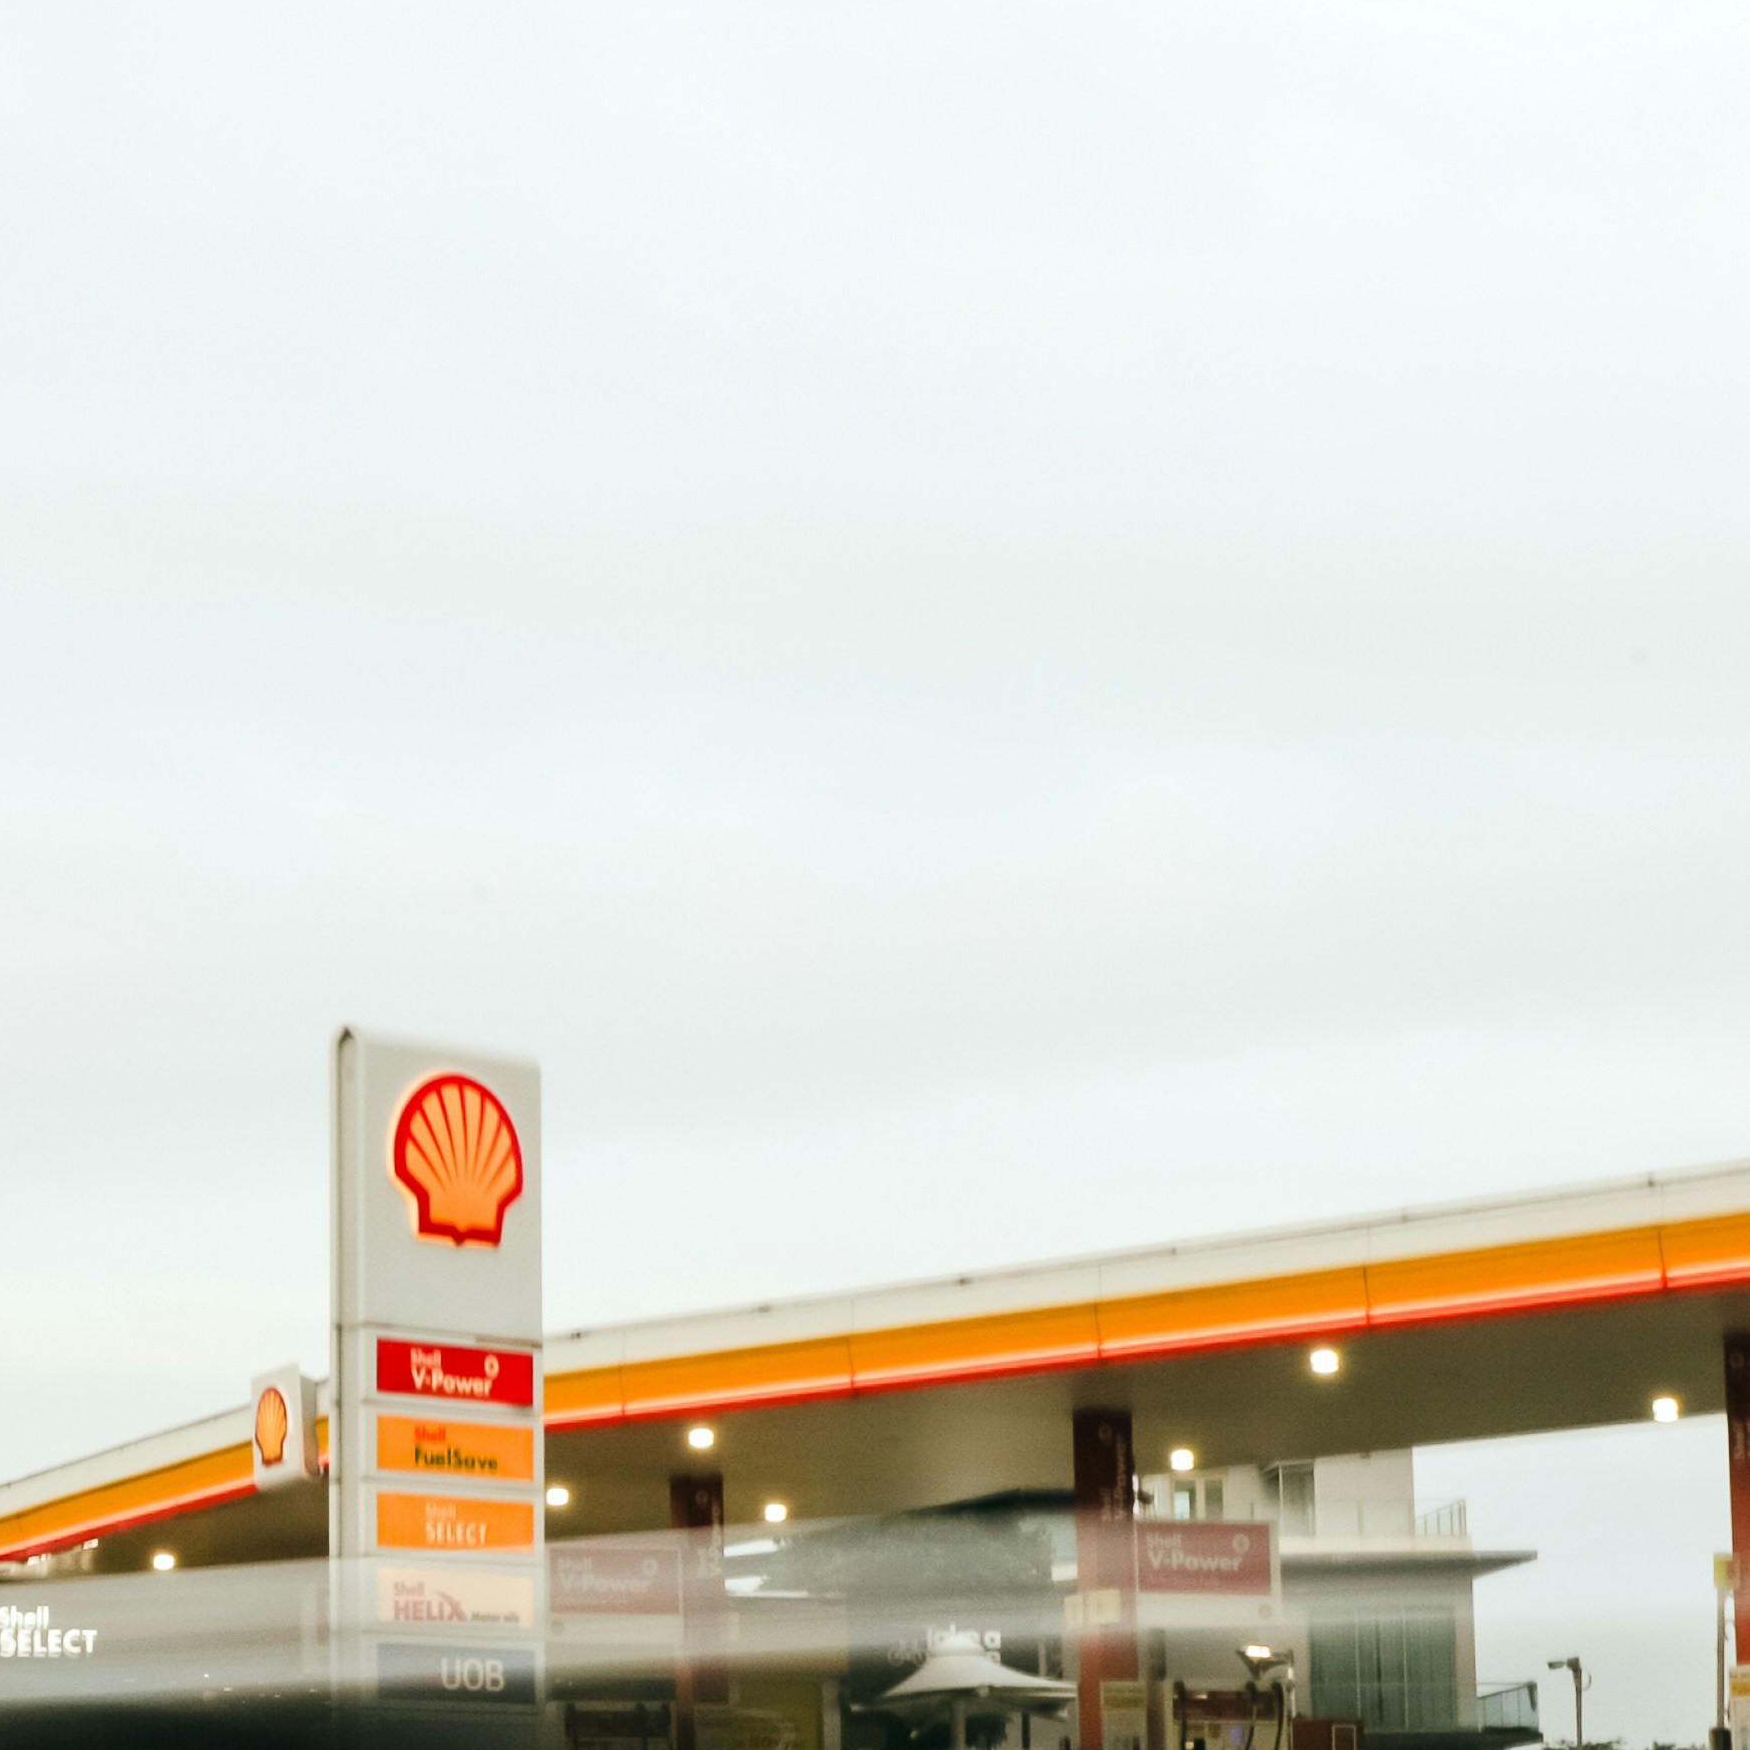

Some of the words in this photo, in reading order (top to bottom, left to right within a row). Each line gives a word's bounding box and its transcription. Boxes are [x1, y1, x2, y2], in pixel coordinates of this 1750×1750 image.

[410, 1348, 442, 1367] Shell
[411, 1368, 493, 1396] V-Power
[414, 1426, 446, 1442] Shell
[415, 1446, 498, 1469] FuelSave
[425, 1503, 457, 1520] Shell
[425, 1522, 488, 1546] SELECT
[1147, 1532, 1182, 1548] Shell
[1147, 1549, 1243, 1571] V-Power
[393, 1582, 425, 1597] Shell
[393, 1590, 466, 1623] HELIX
[0, 1628, 98, 1658] SELECT
[441, 1657, 505, 1691] UOB
